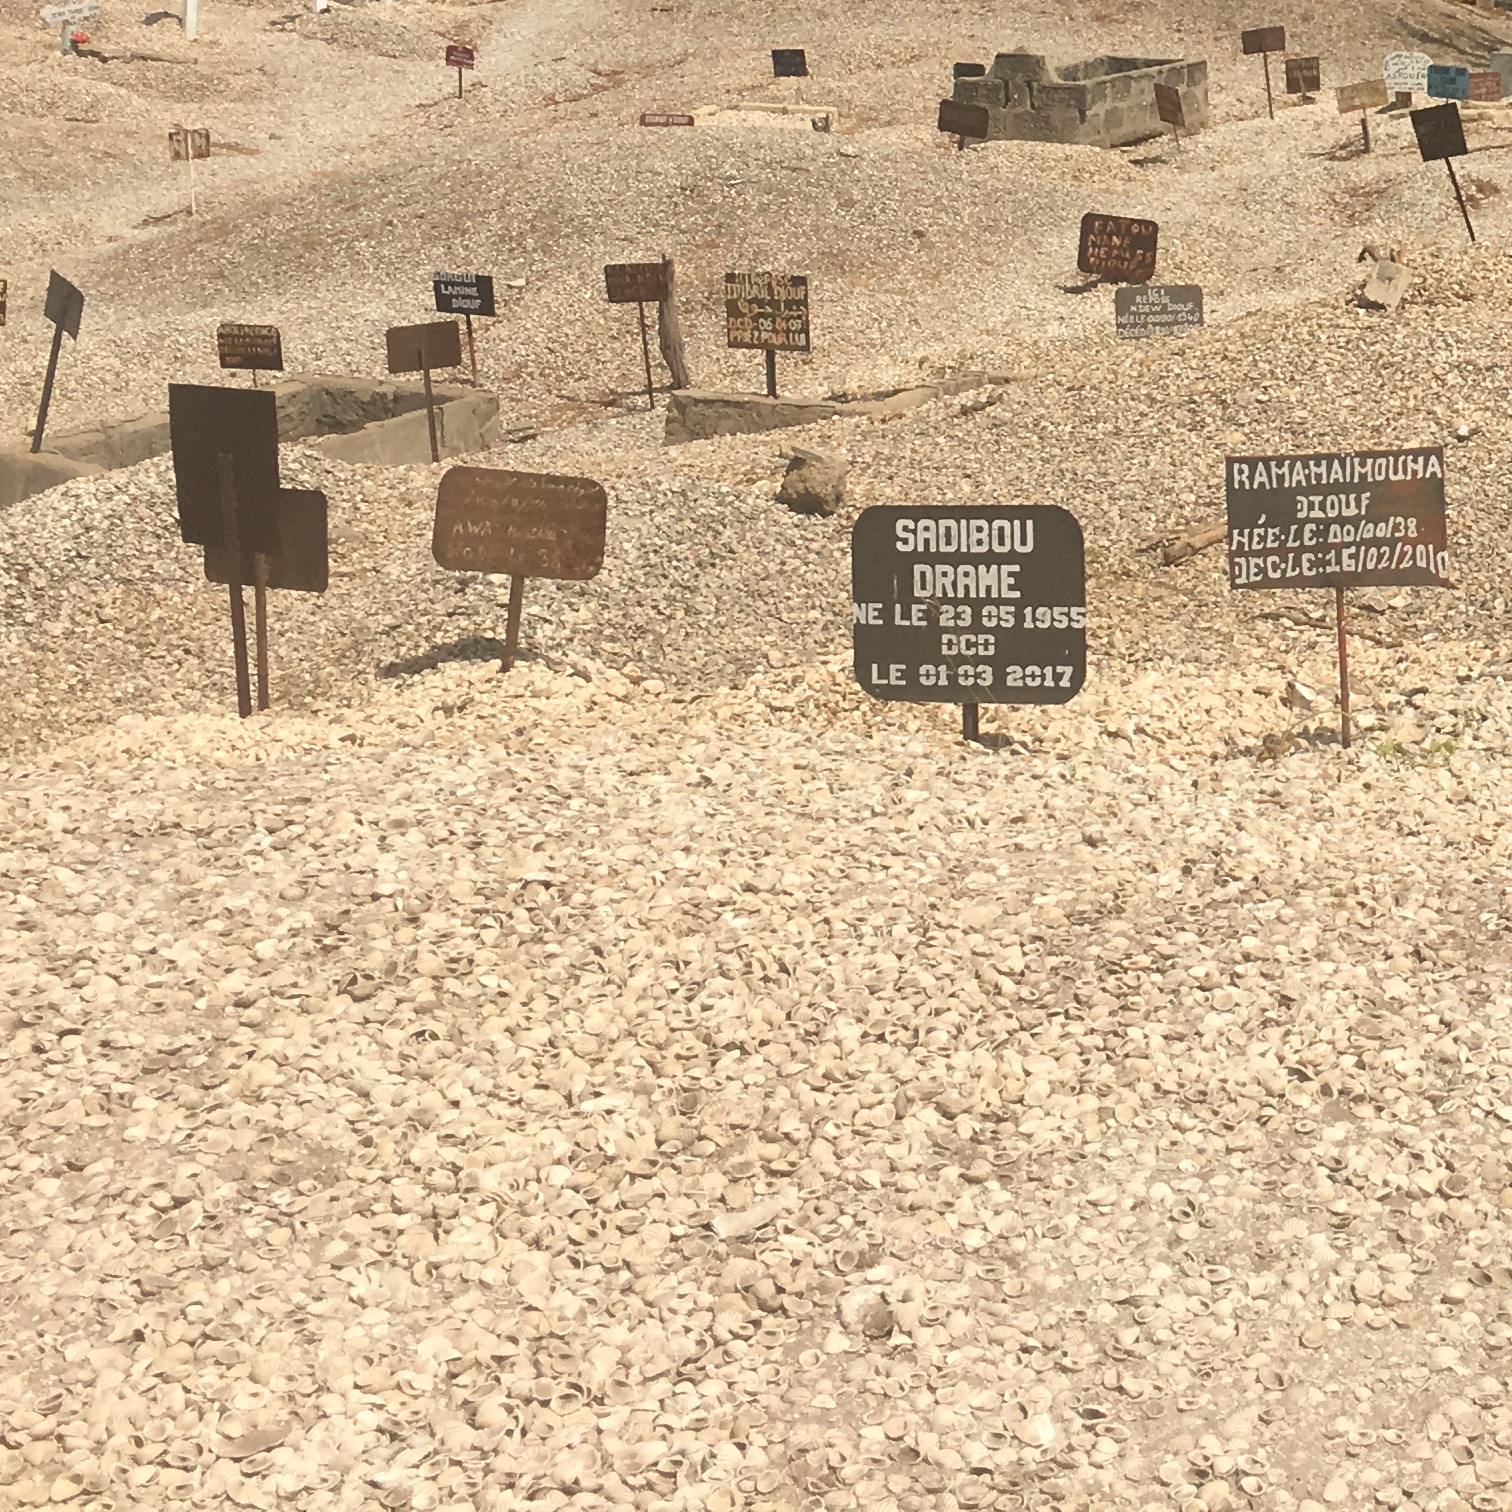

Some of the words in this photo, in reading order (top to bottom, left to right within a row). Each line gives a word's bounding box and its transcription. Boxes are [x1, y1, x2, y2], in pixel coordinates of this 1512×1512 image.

[1093, 220, 1153, 236] FATOU
[441, 284, 479, 296] LAMINE
[452, 297, 482, 309] DIOUF
[1296, 492, 1371, 518] DIOUF
[895, 518, 1034, 553] SADIBOU
[913, 563, 1021, 598] DRAME
[853, 602, 884, 625] NE
[894, 603, 928, 626] LE
[939, 605, 972, 627] 23
[981, 605, 1016, 628] 05
[1023, 606, 1087, 629] 1955
[941, 634, 996, 656] DCD
[871, 663, 907, 686] LE
[919, 664, 949, 687] 01
[957, 664, 993, 686] 03
[1006, 665, 1073, 687] 2017
